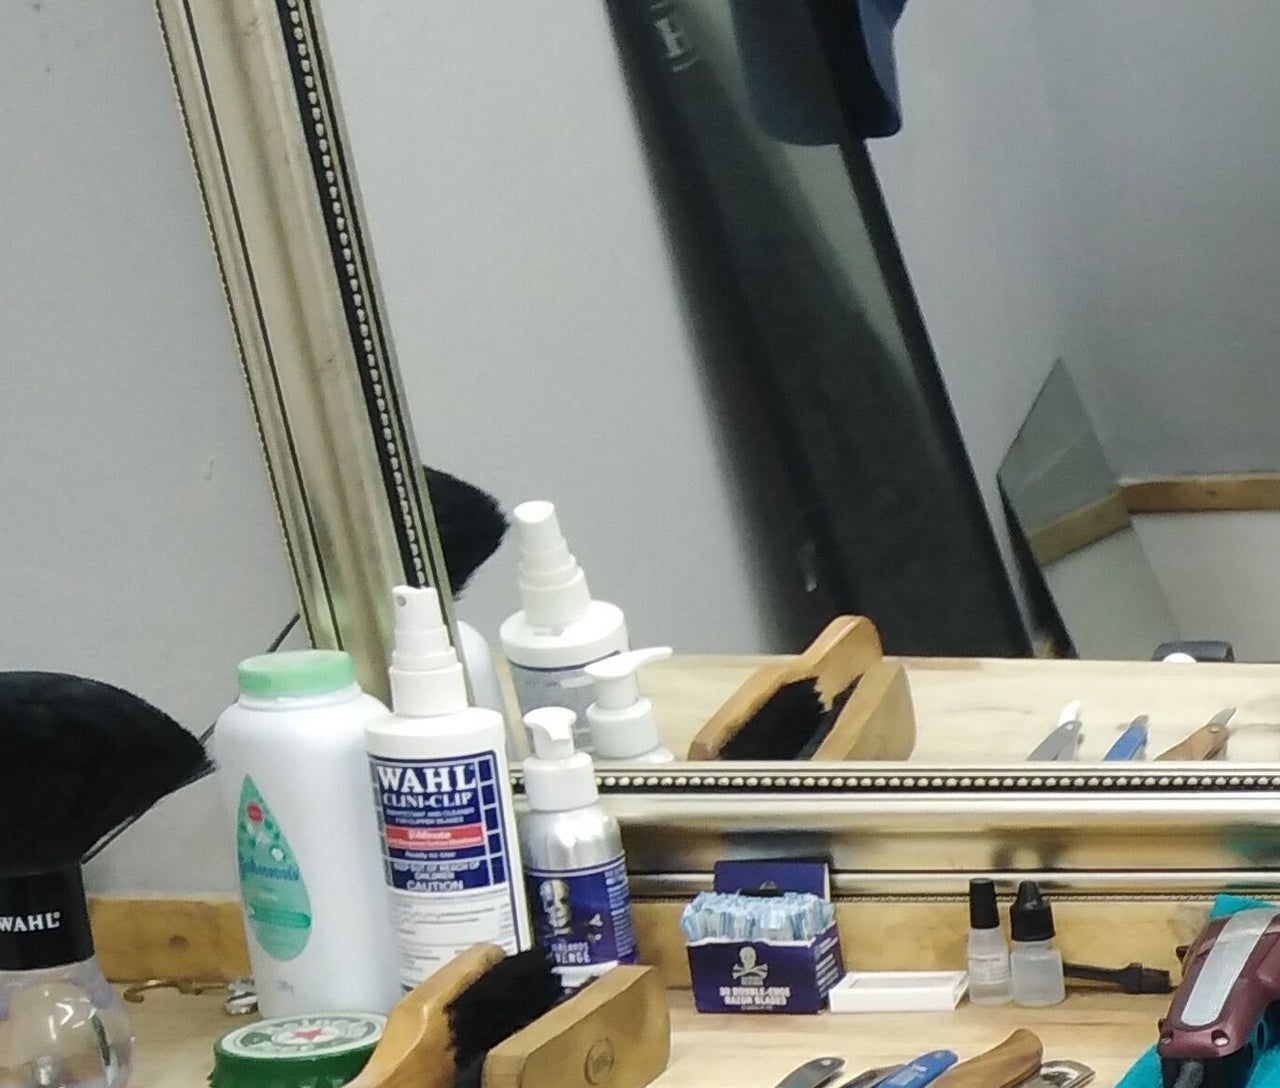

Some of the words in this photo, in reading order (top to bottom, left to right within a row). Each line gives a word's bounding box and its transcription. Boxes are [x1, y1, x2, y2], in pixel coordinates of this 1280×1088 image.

[376, 764, 476, 794] WAHL
[382, 791, 473, 808] CLINI-CLIP
[0, 913, 60, 933] WAHL
